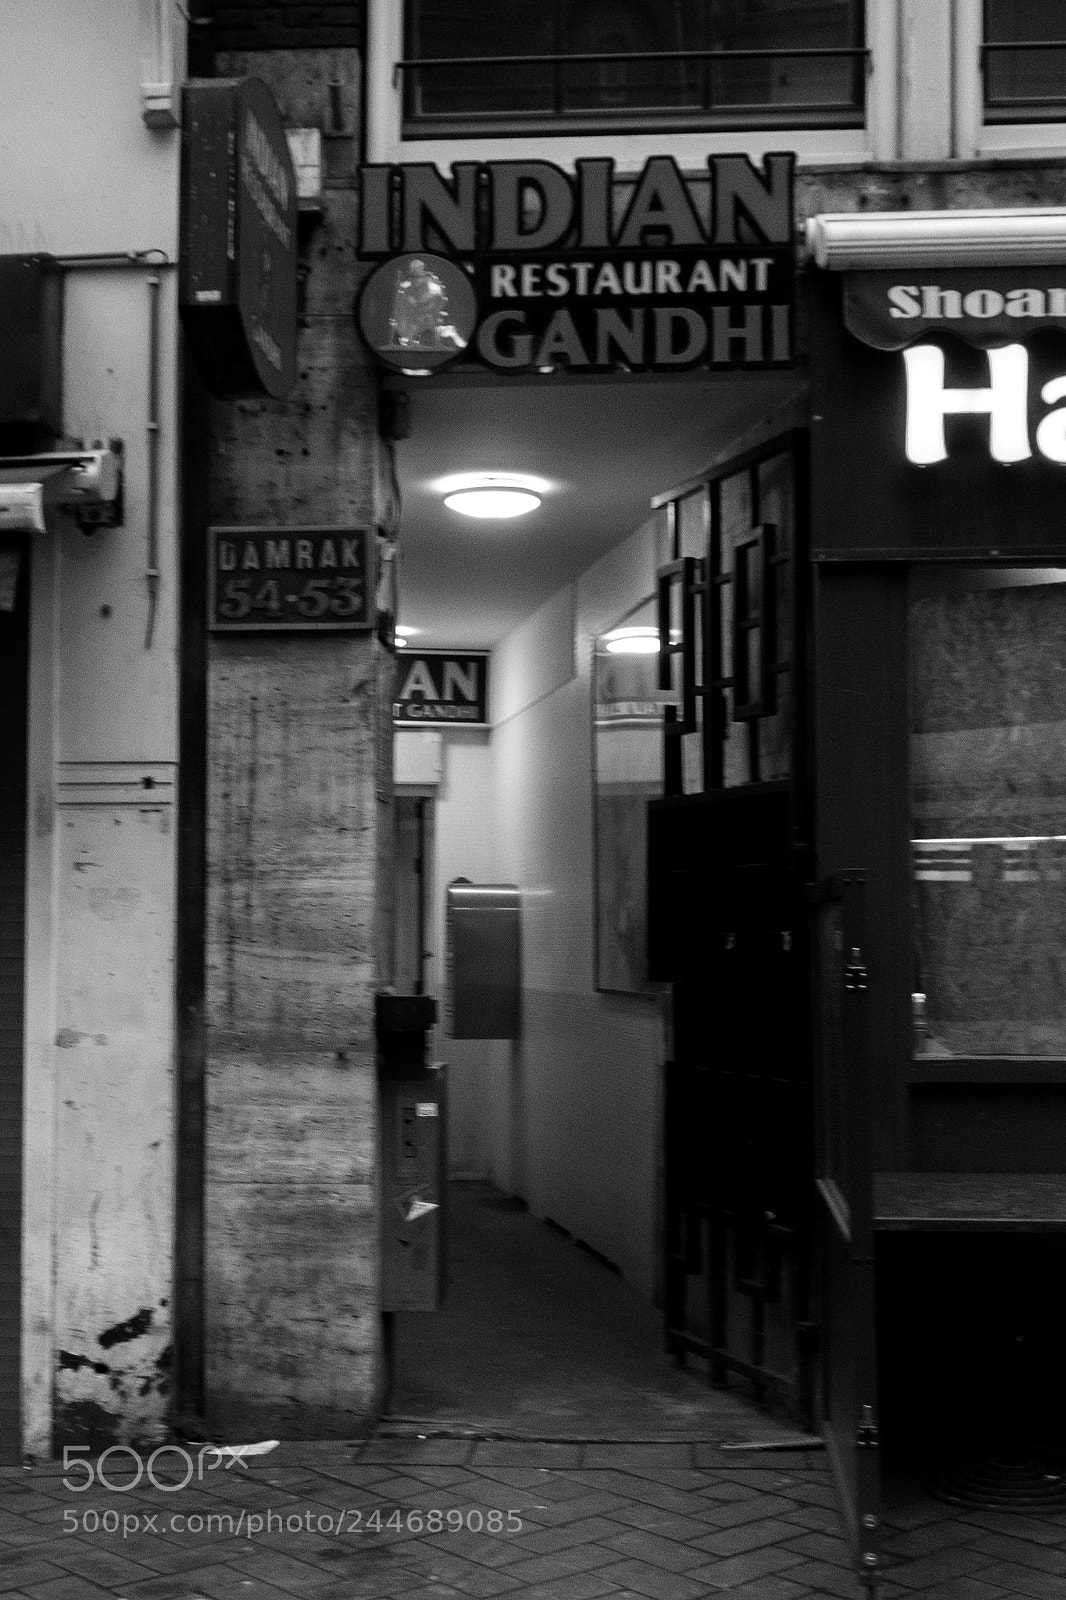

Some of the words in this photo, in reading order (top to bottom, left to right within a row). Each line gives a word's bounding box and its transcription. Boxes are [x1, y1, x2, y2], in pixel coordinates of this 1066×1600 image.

[360, 153, 796, 253] INDIAN
[490, 258, 774, 298] RESTAURANT
[477, 304, 791, 367] GANDHI
[218, 539, 360, 571] DAMRAK
